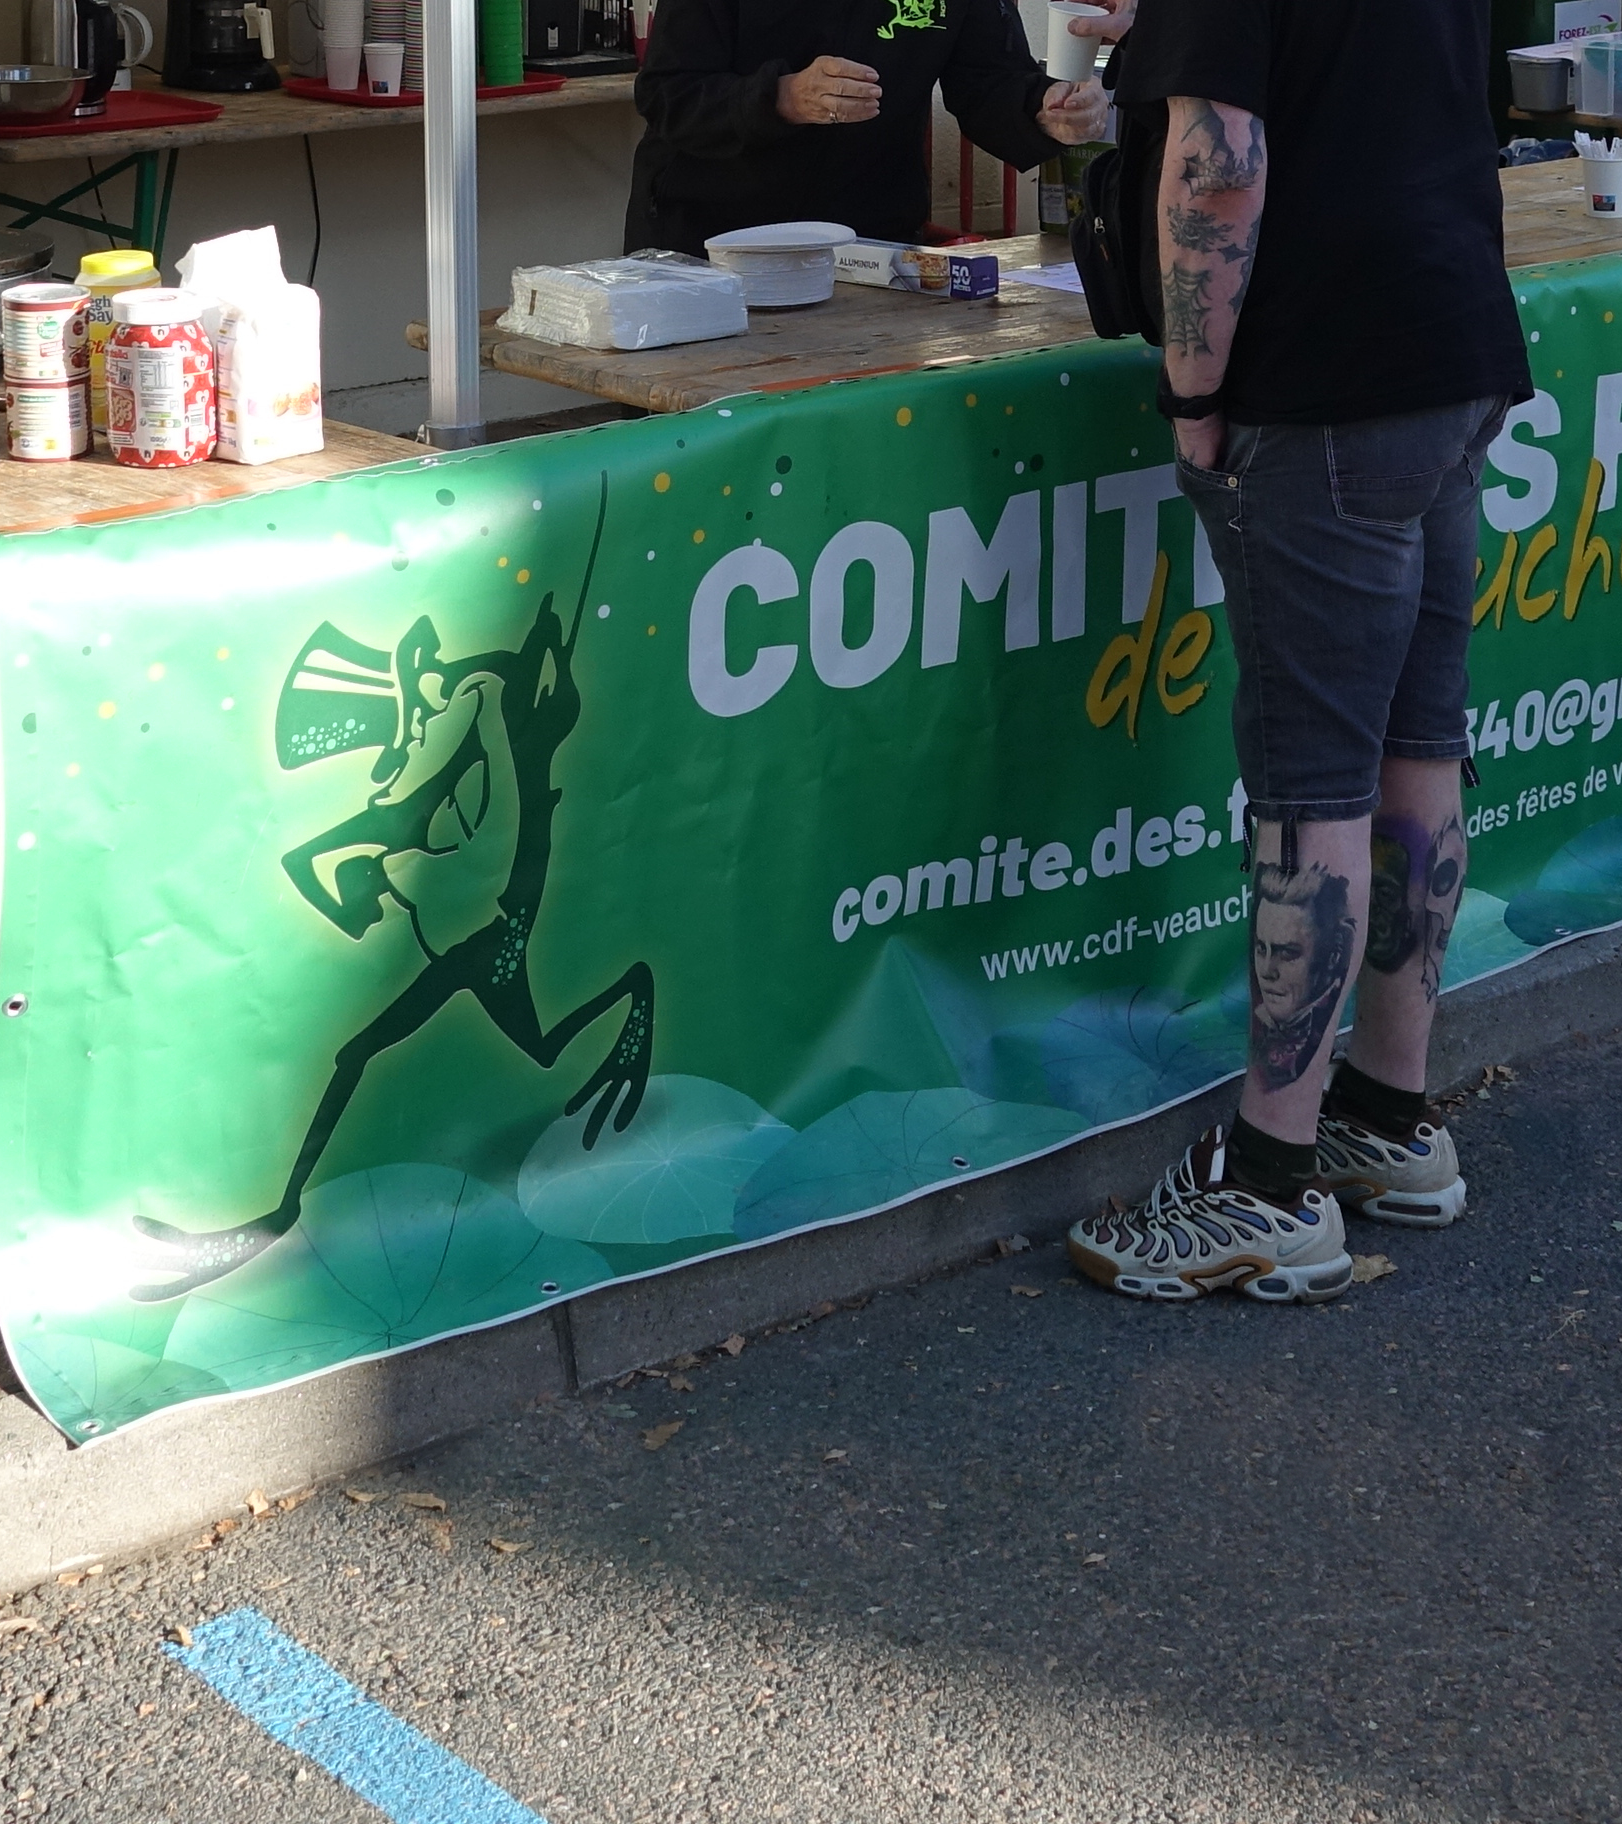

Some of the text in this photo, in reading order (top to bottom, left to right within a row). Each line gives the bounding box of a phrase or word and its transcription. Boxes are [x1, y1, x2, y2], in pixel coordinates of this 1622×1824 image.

[839, 256, 879, 270] ALUMINIUM
[951, 264, 972, 286] 50
[1085, 550, 1213, 742] de
[1466, 799, 1510, 839] des
[1516, 780, 1577, 821] fêtes
[1582, 765, 1608, 799] de
[831, 776, 1250, 943] comite.des.f
